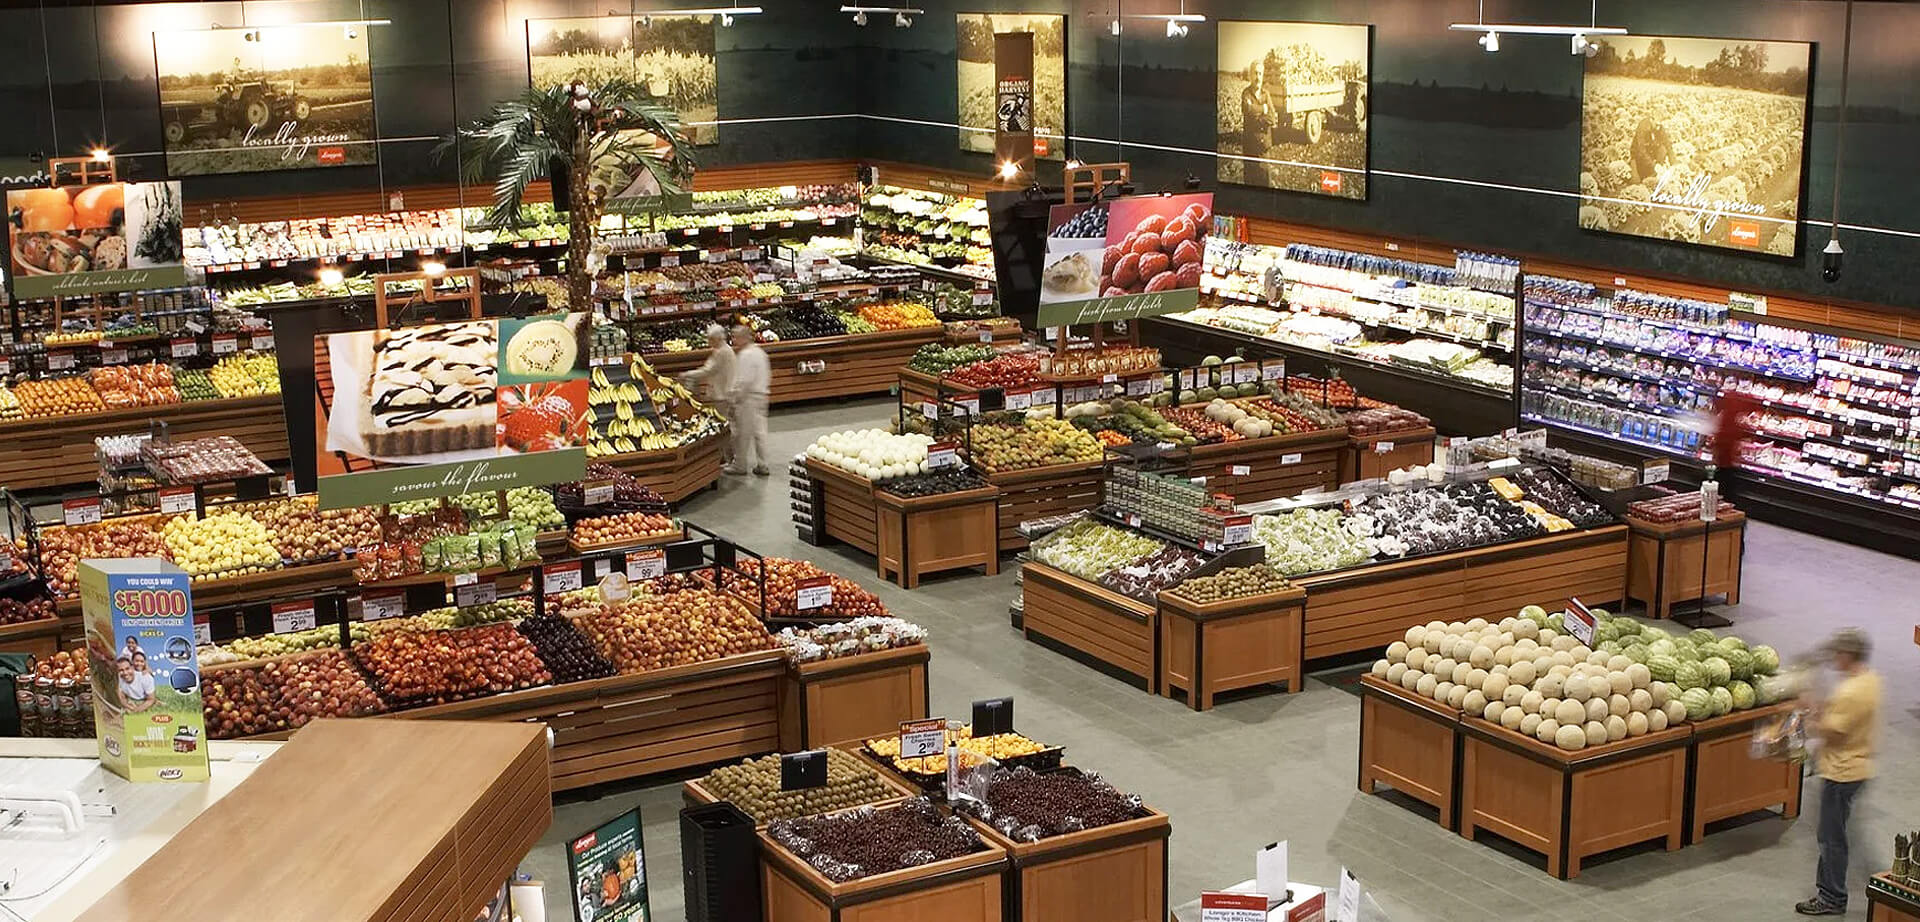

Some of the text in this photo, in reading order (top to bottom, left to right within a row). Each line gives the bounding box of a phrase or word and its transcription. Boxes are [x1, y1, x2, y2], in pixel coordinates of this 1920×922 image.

[242, 121, 350, 160] locally grown
[1651, 170, 1766, 233] locally grown
[1075, 294, 1163, 324] fresh from the fields
[392, 462, 517, 495] savour the flavour
[114, 589, 187, 617] $5000
